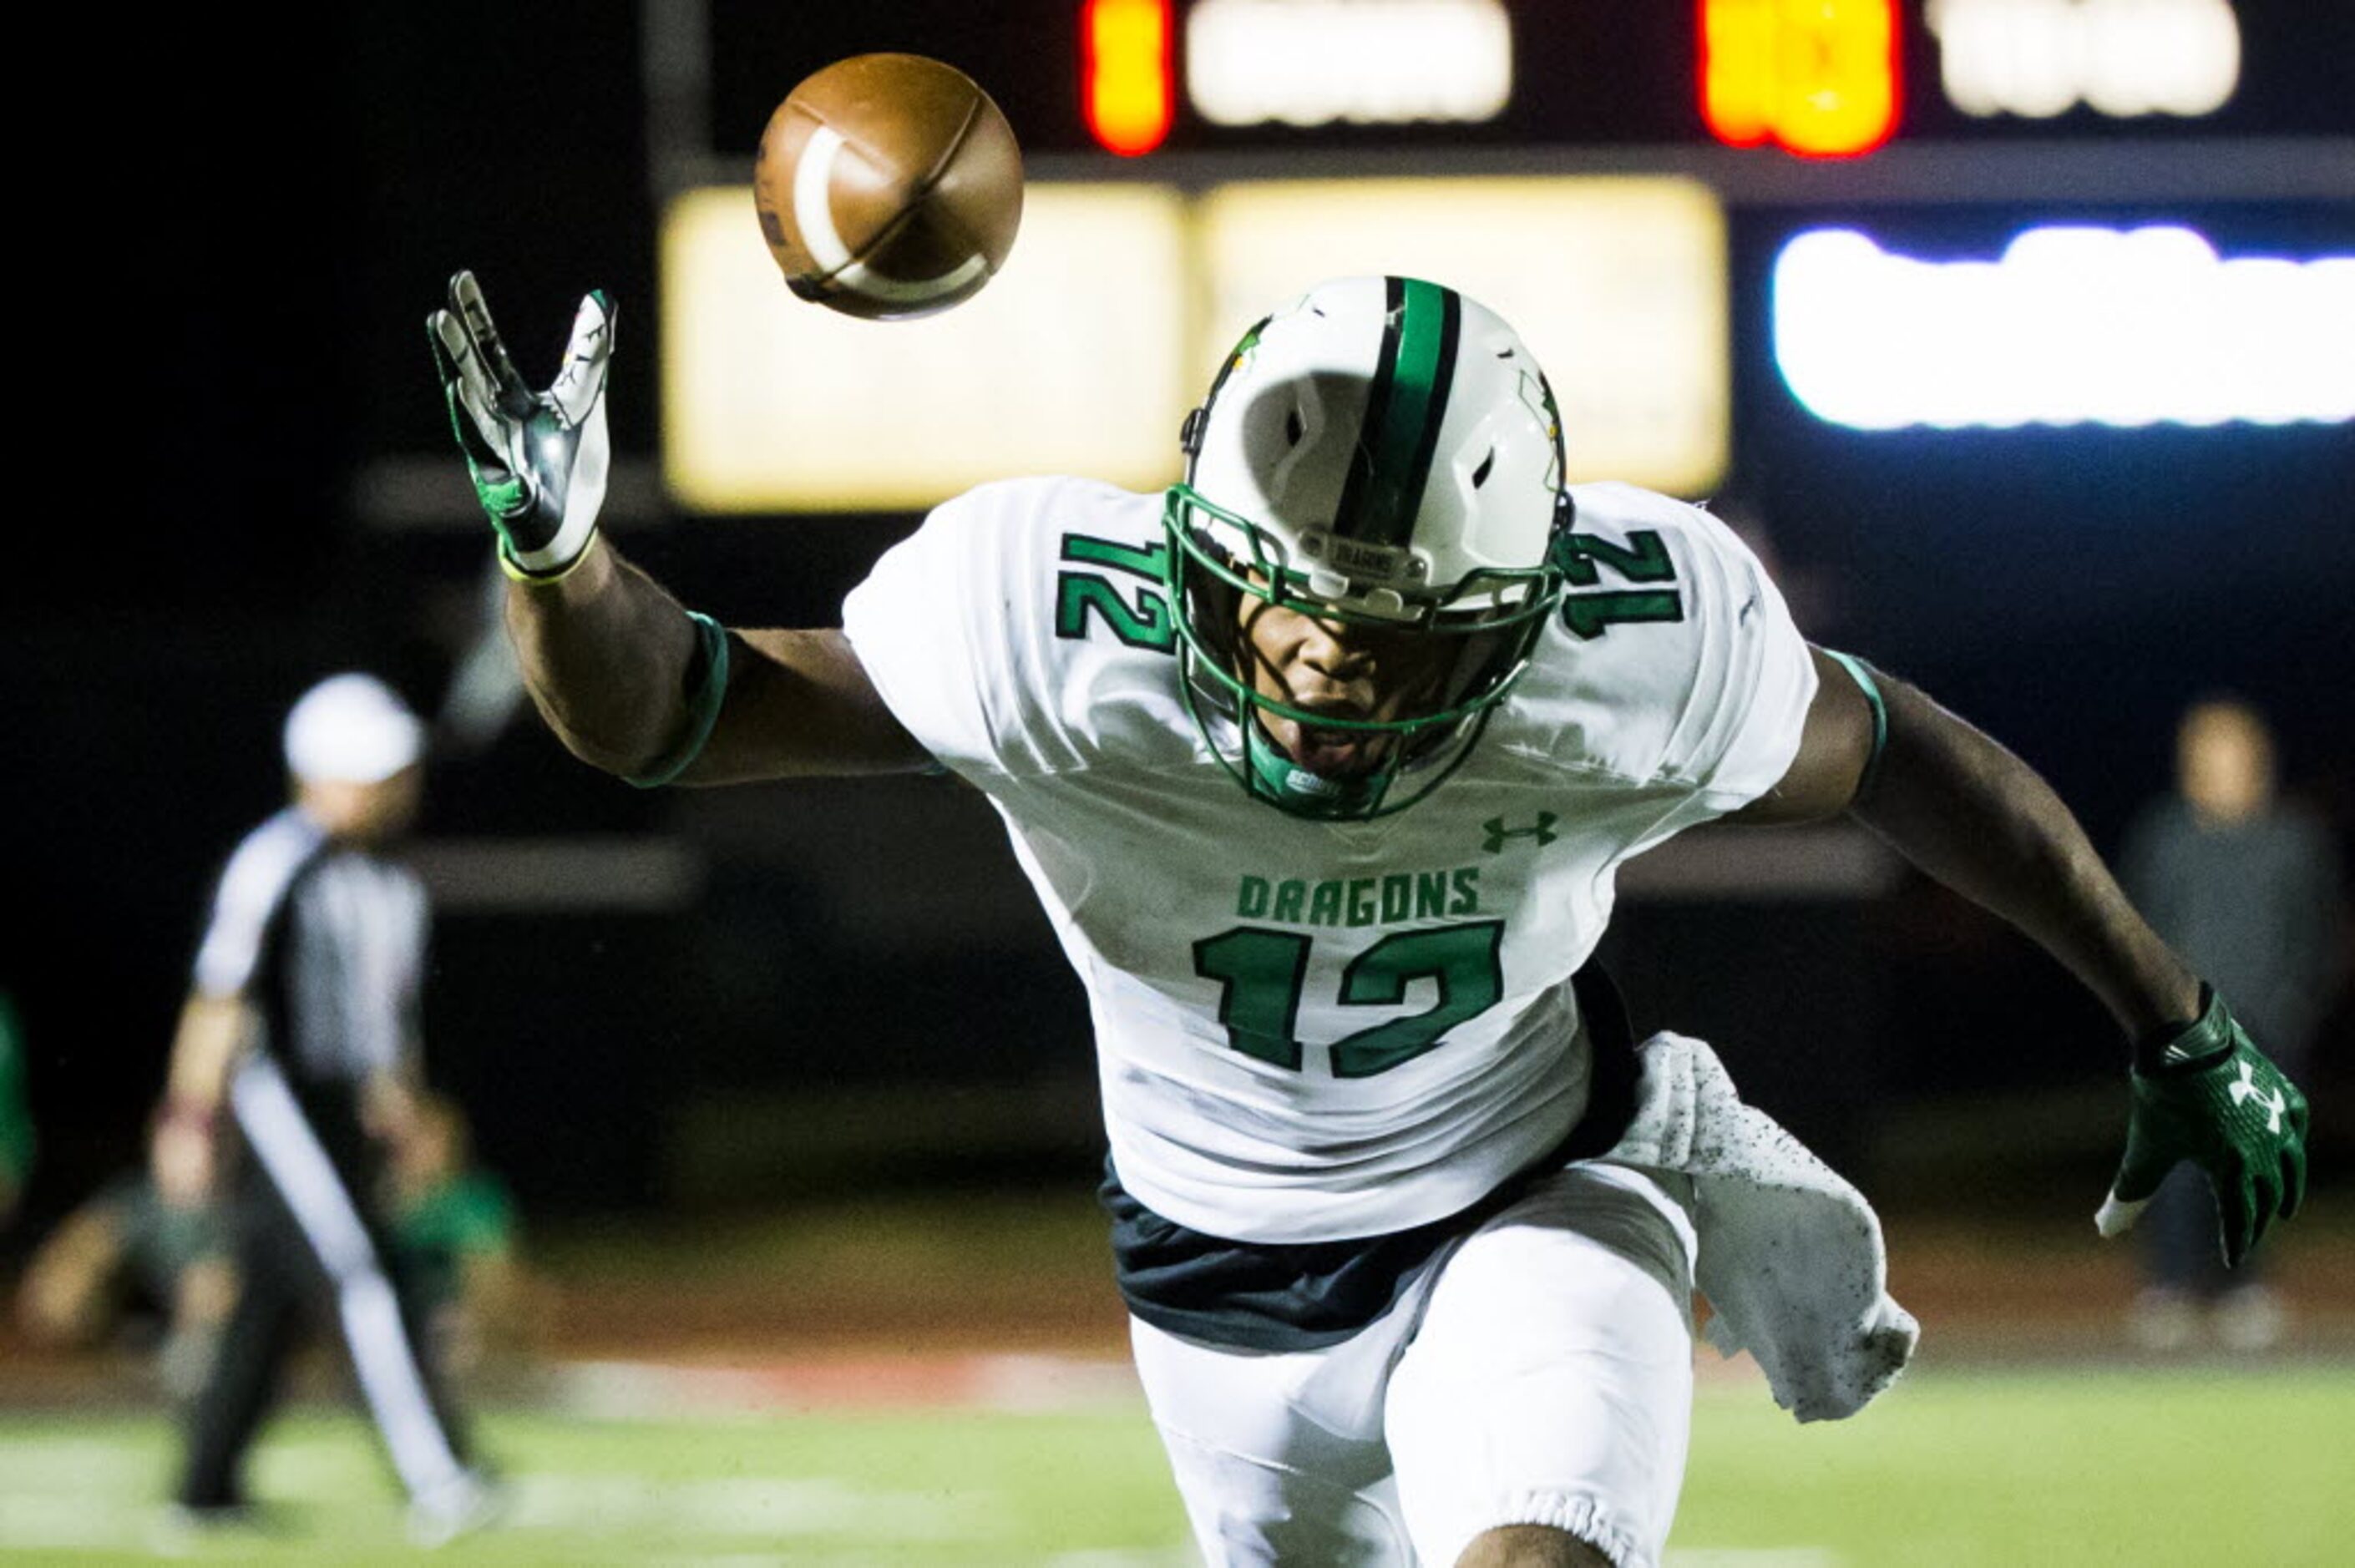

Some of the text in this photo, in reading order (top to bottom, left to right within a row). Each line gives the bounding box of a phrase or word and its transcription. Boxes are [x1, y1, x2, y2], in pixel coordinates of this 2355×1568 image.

[1056, 533, 1175, 655] 12
[1552, 529, 1684, 641] 12
[1237, 867, 1480, 927] DRAGONS
[1192, 919, 1506, 1079] 12
